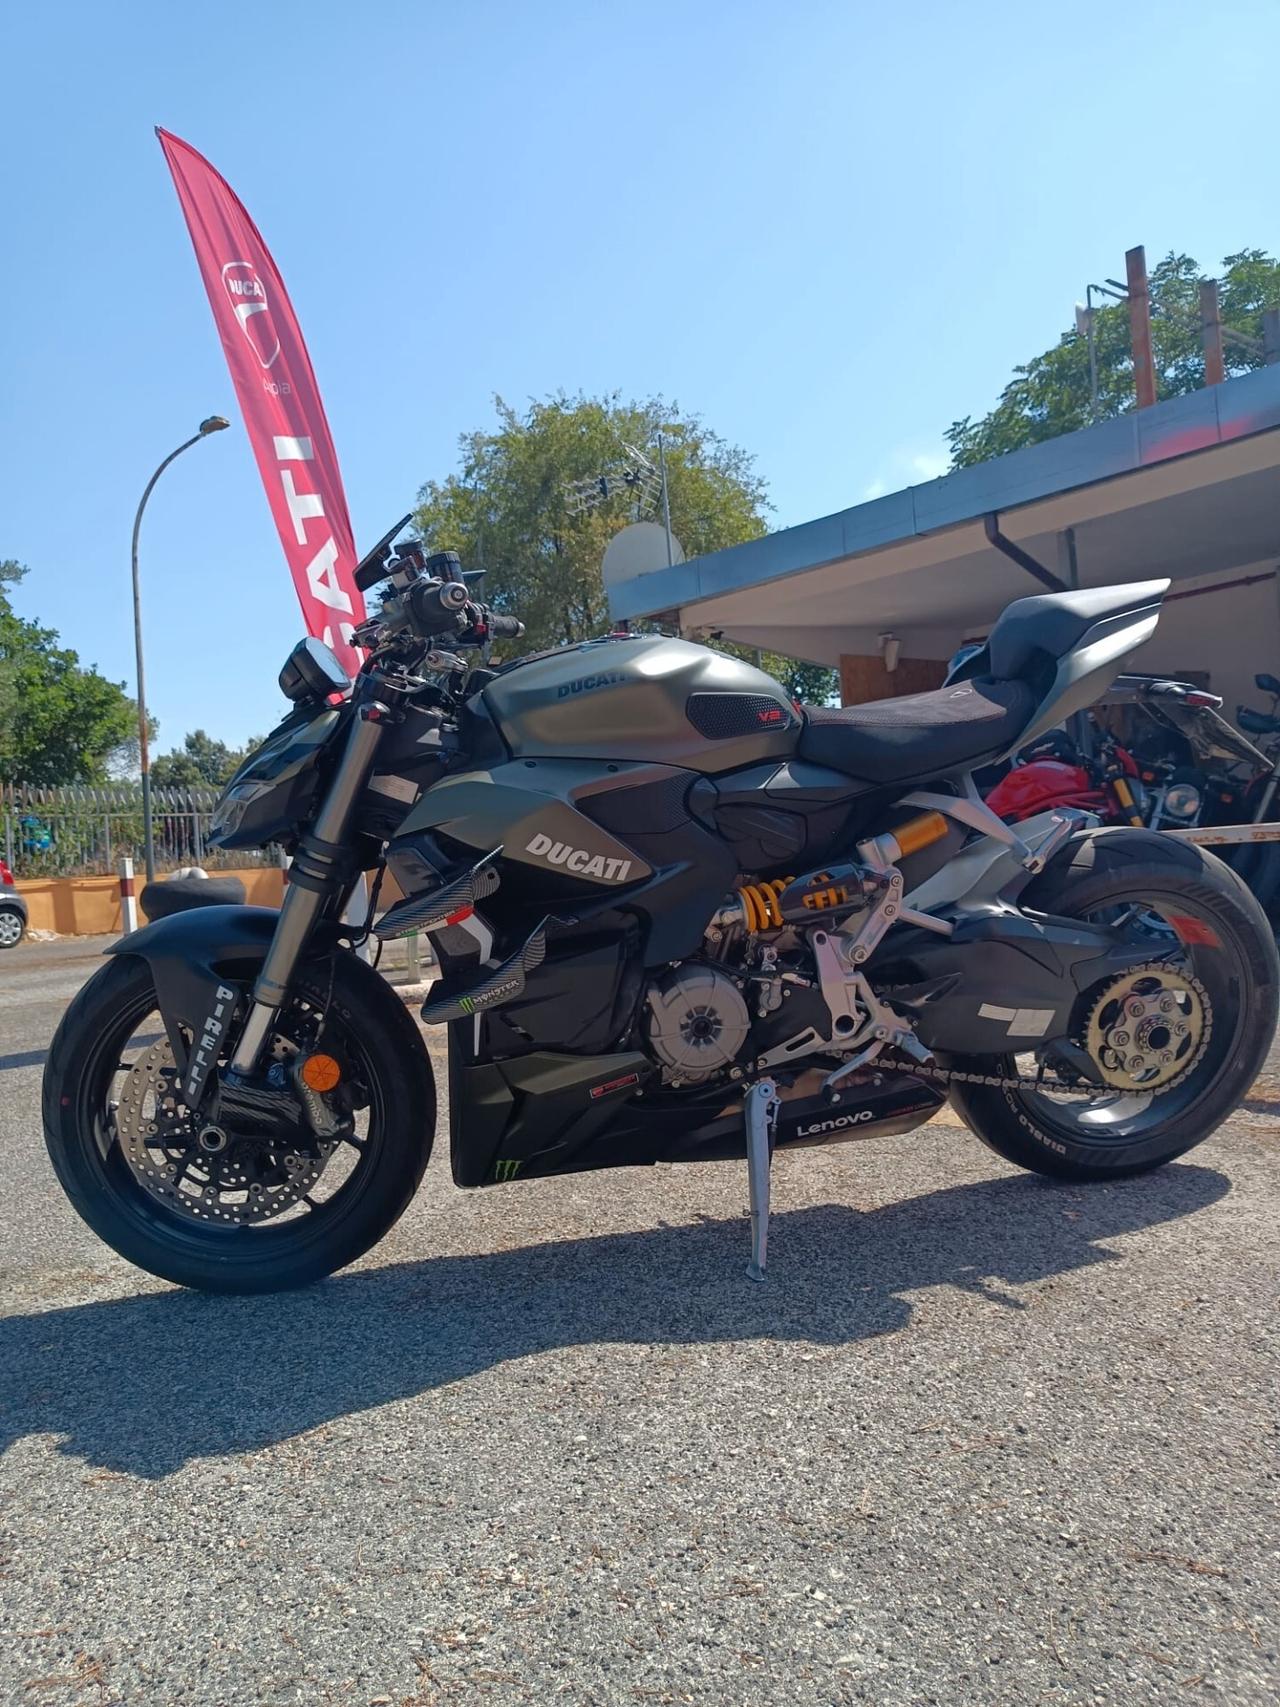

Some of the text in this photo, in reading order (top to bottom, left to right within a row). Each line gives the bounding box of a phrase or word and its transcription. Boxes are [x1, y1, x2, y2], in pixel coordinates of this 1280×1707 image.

[525, 832, 632, 881] DUCATI
[472, 978, 520, 1005] MONSTER
[187, 984, 234, 1096] PIRELLI
[796, 1110, 873, 1137] Lenovo
[1018, 1114, 1067, 1155] DIABLO
